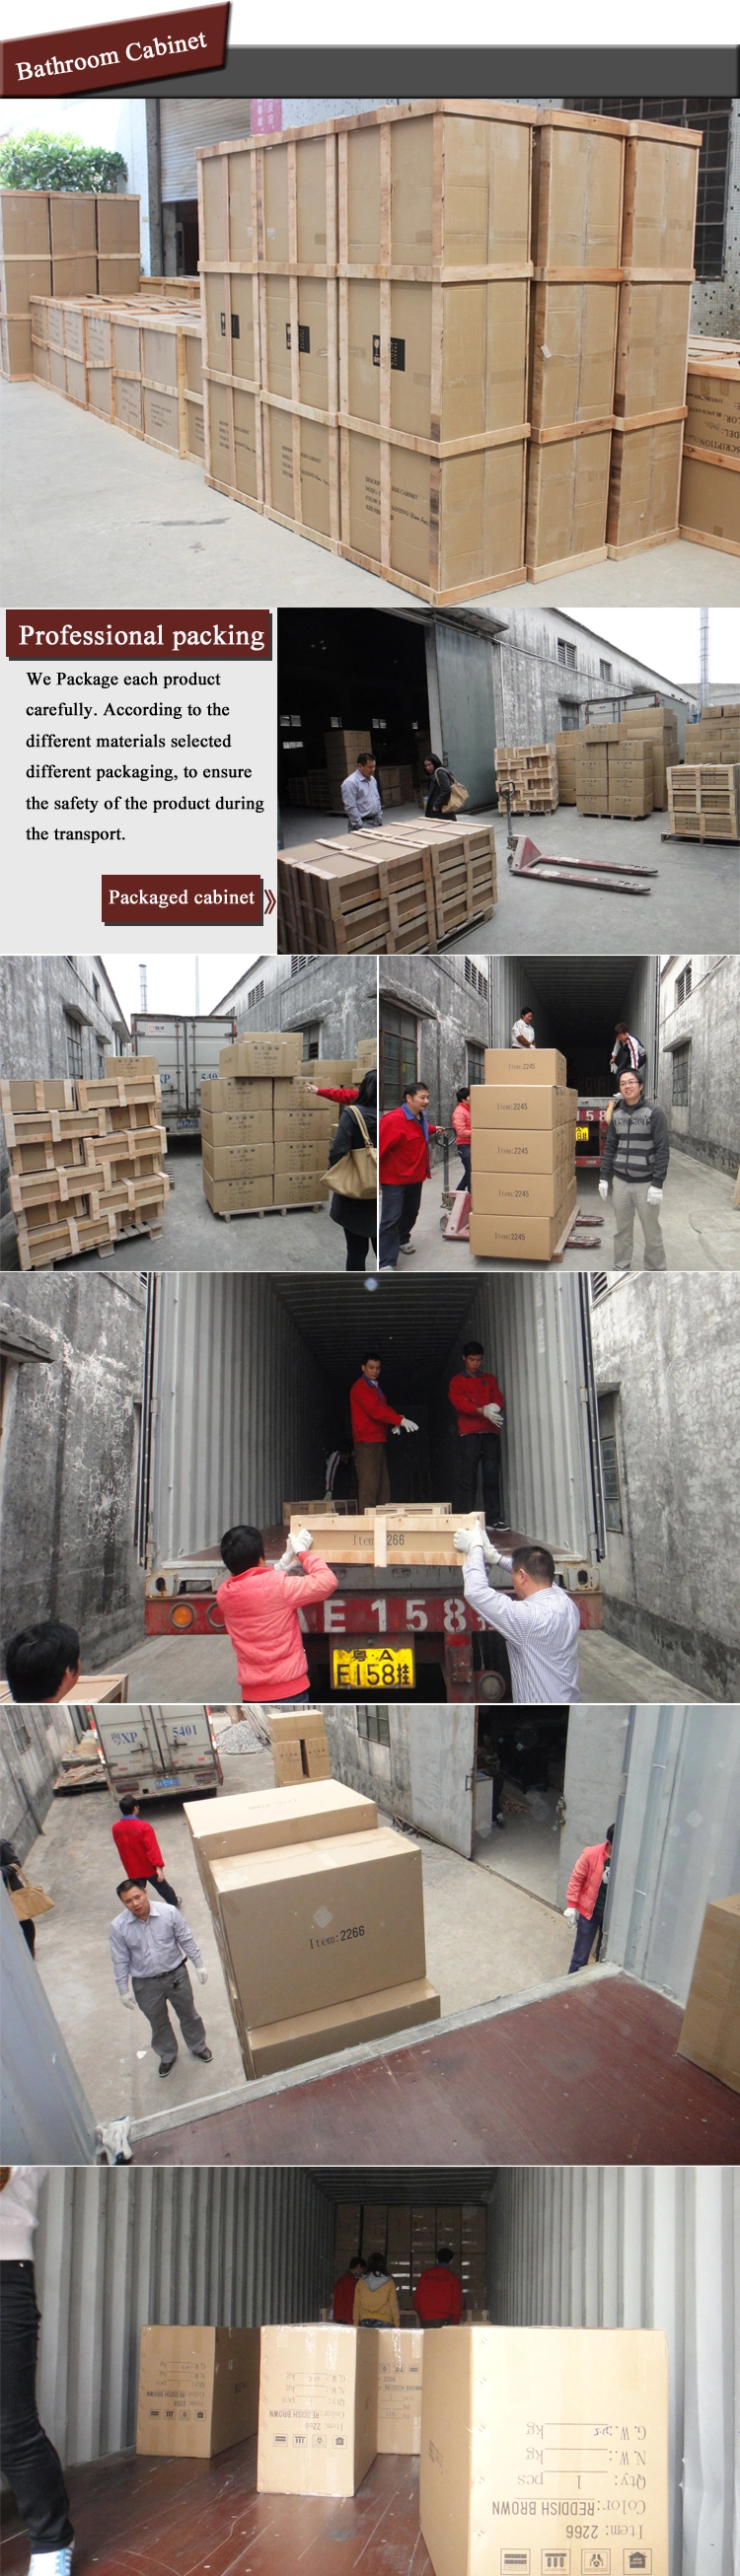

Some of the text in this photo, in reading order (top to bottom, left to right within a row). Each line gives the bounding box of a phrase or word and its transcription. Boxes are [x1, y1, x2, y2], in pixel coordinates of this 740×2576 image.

[173, 1725, 198, 1738] 5401
[309, 1925, 365, 1950] Item:2266
[286, 2372, 295, 2381] kg
[328, 2397, 345, 2406] Qty:
[320, 2410, 345, 2419] Color:
[324, 2422, 343, 2431] Item:
[526, 2423, 544, 2440] kg
[526, 2447, 544, 2466] kg
[517, 2473, 646, 2490] Qty: 1 pcs
[492, 2499, 646, 2516] Color: REDDISH BROWN
[565, 2525, 644, 2540] Item: 2266
